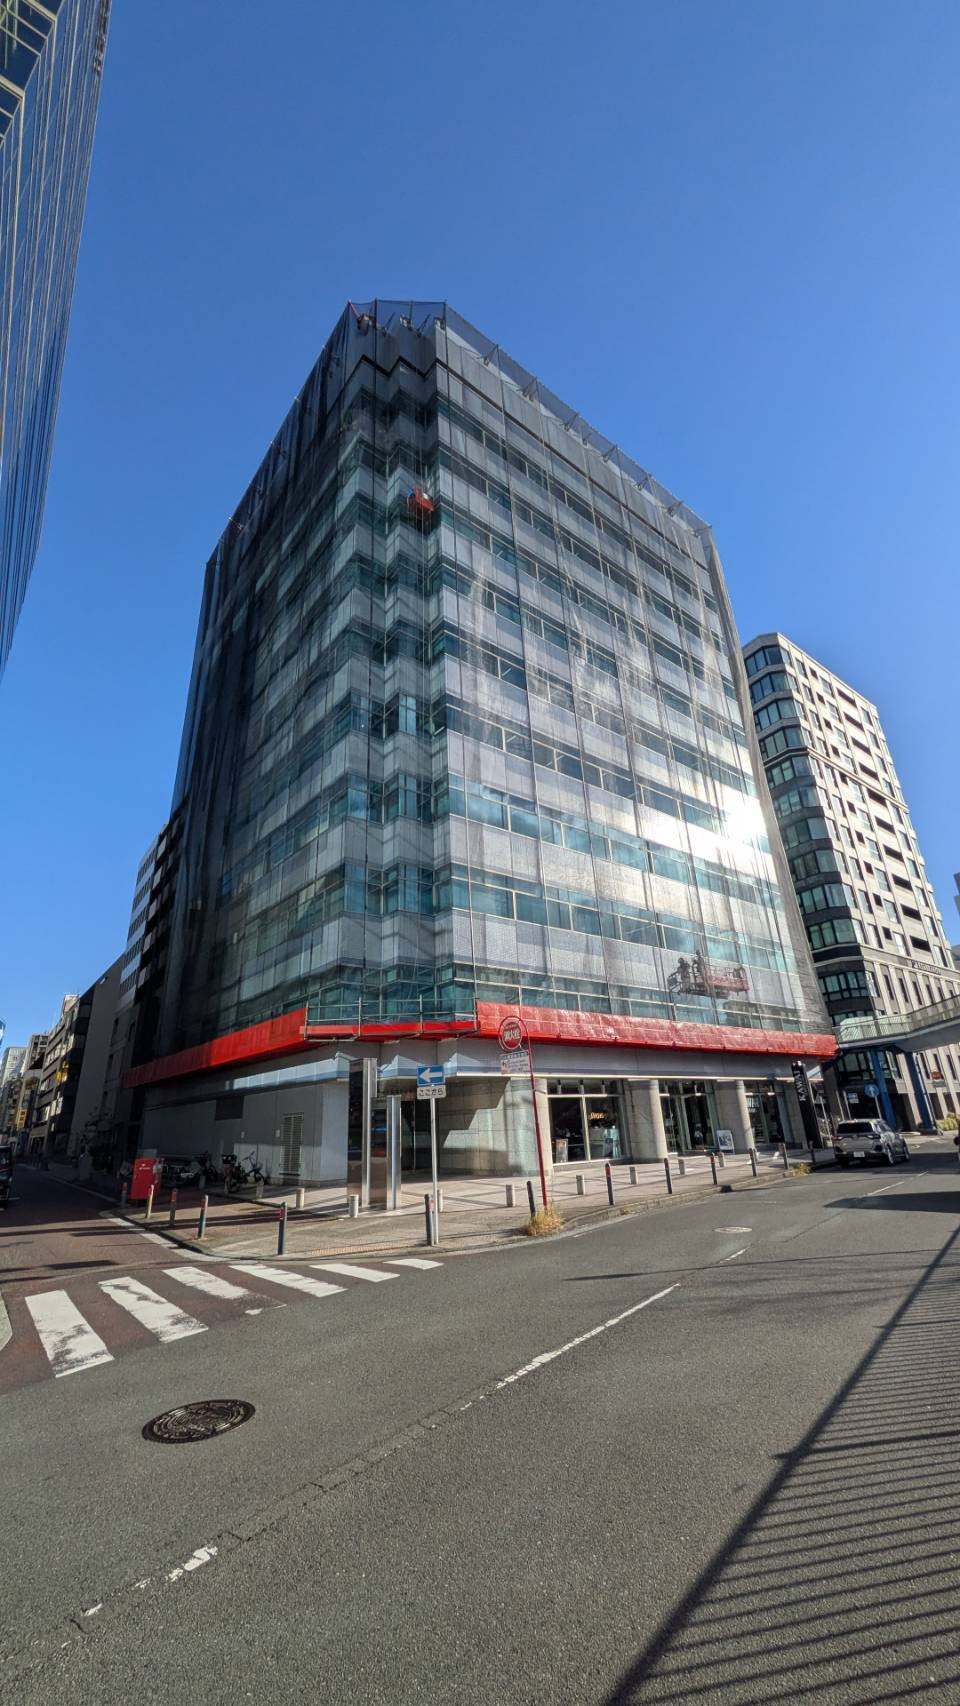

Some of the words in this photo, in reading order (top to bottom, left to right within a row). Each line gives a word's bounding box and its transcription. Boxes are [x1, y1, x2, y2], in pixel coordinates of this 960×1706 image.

[418, 1088, 444, 1097] ここから
[793, 1070, 808, 1102] KAWAI
